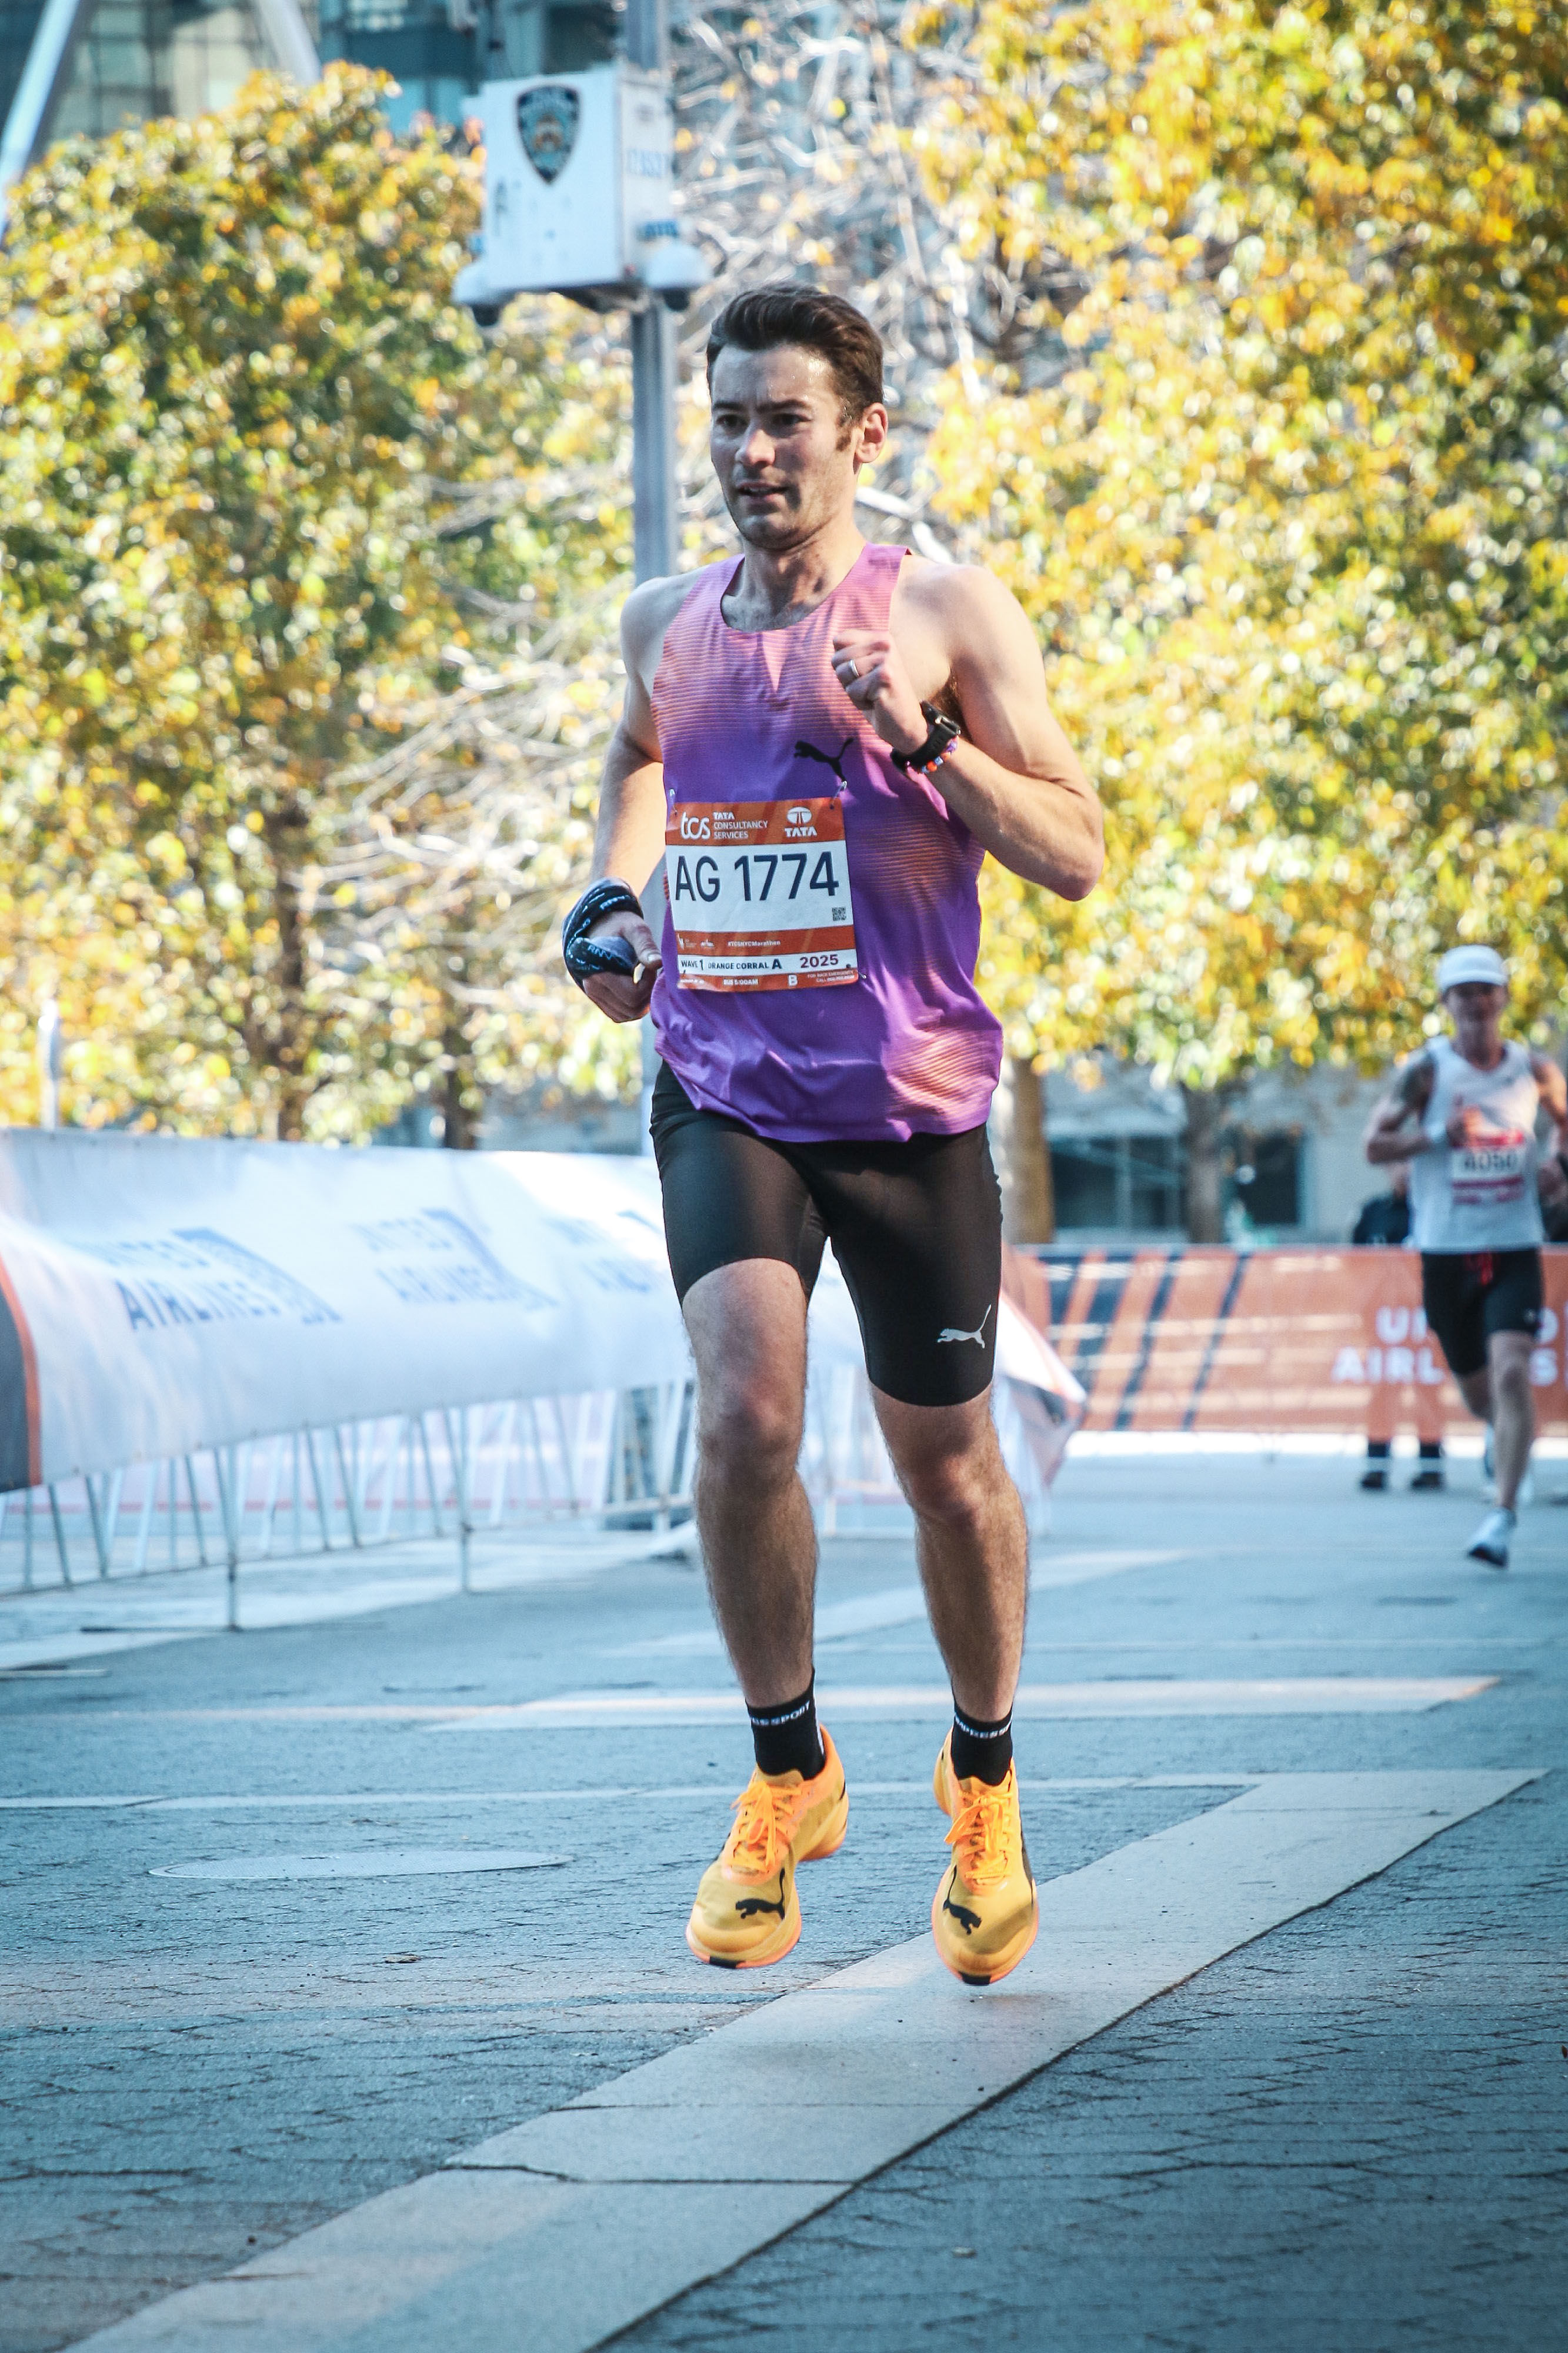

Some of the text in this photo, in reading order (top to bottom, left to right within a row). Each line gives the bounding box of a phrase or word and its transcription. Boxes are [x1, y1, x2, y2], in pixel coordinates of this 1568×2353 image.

[713, 812, 735, 820] TATA
[680, 811, 710, 839] tcs
[713, 820, 768, 829] CONSULTANCY
[713, 830, 749, 839] SERVICES
[784, 826, 818, 838] TATA
[675, 851, 840, 902] AG 1774
[699, 959, 703, 971] 1
[736, 961, 769, 969] CORRAL
[772, 959, 782, 969] A
[800, 954, 839, 968] 2025
[788, 974, 799, 987] B
